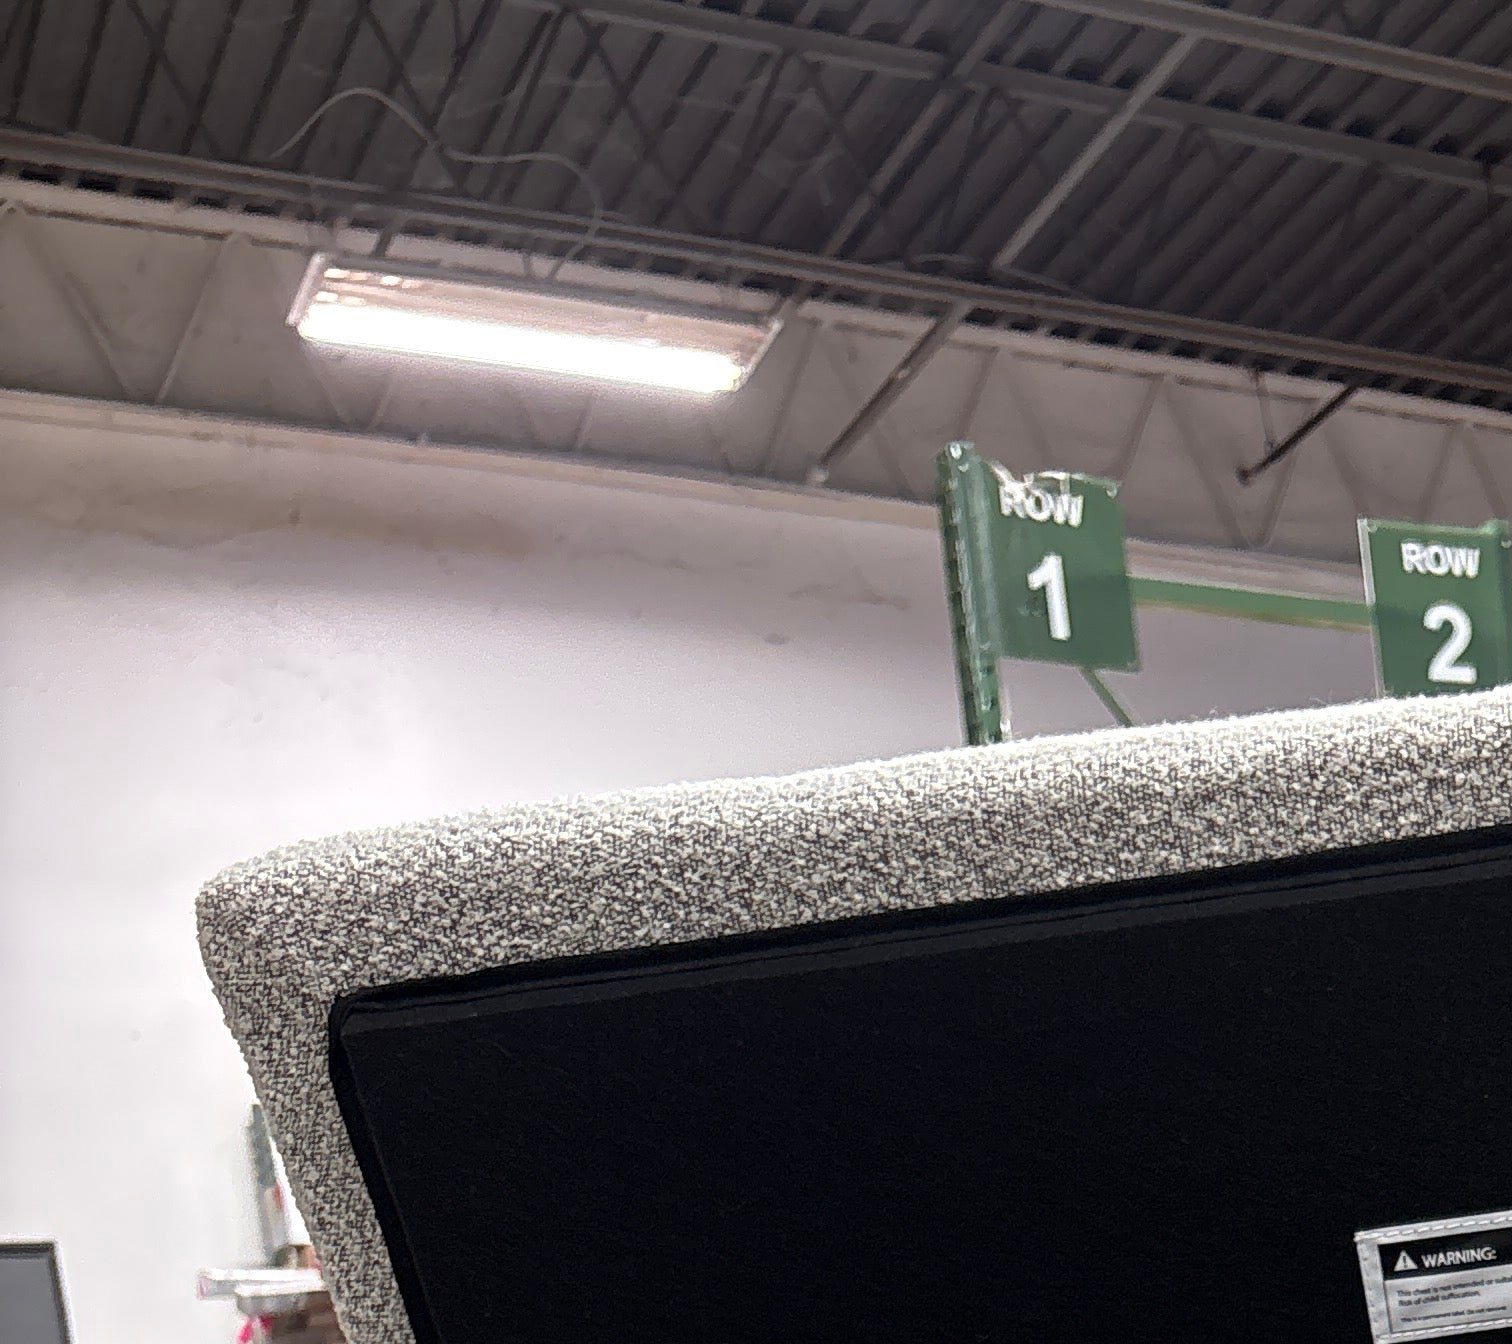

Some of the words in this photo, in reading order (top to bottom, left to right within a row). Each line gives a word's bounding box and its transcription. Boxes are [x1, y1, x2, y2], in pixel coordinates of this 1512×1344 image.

[998, 484, 1085, 528] ROW
[1400, 541, 1481, 579] ROW
[1027, 553, 1071, 641] 1
[1422, 601, 1478, 685] 2
